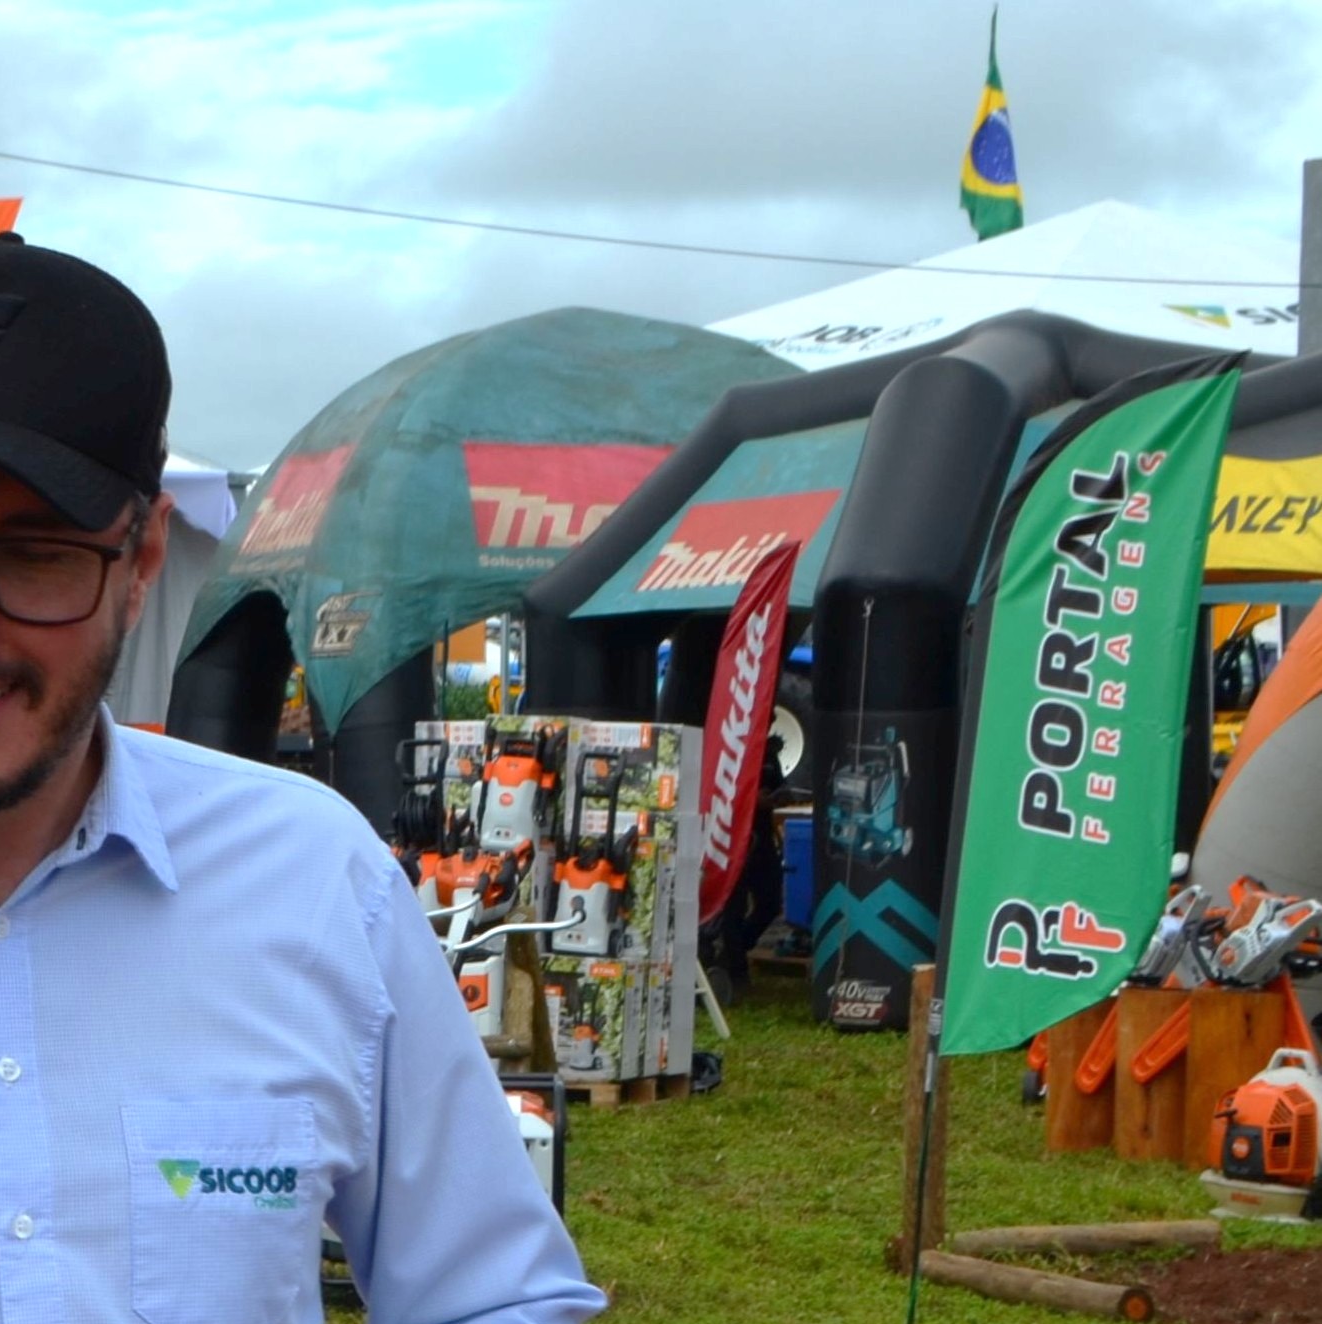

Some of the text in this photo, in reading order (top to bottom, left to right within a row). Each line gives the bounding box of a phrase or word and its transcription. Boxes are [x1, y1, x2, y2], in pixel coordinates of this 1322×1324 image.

[636, 531, 787, 593] makit
[1019, 451, 1129, 838] PORTAL
[1082, 450, 1167, 844] FERRAGENS
[834, 1001, 884, 1018] XGT
[199, 1167, 298, 1194] SICOOB
